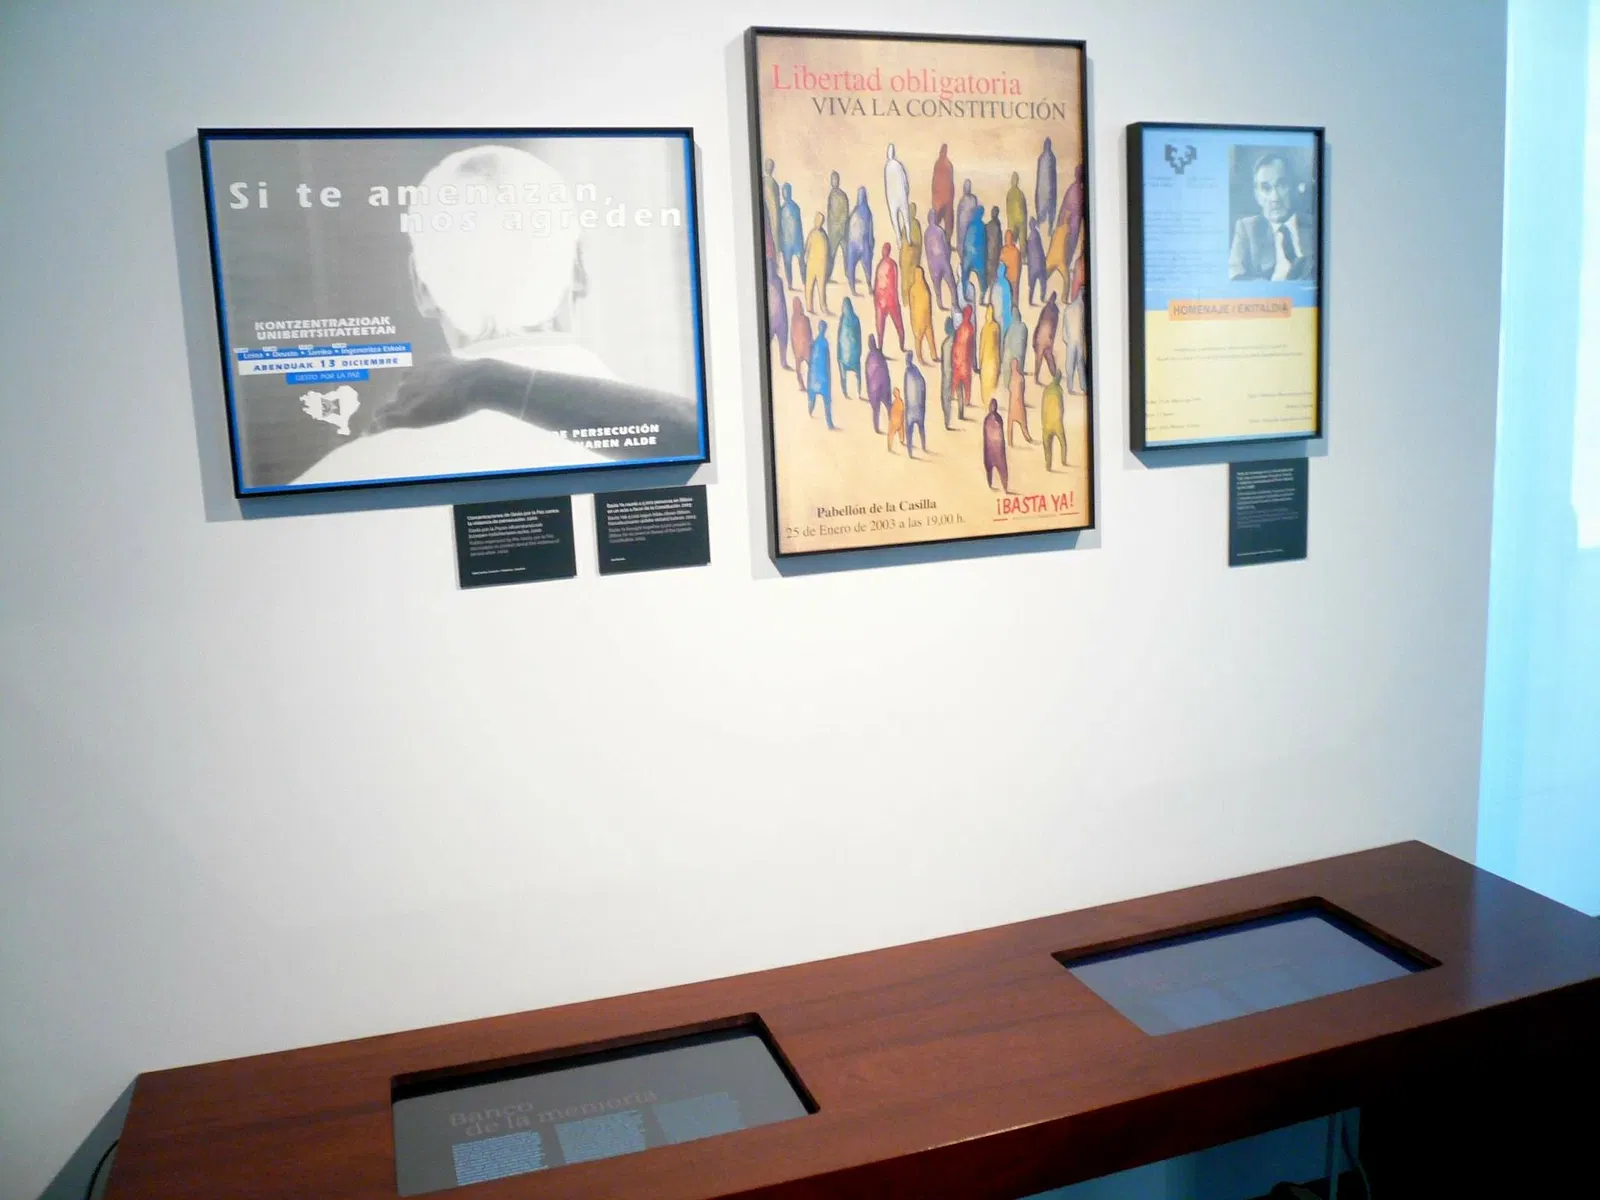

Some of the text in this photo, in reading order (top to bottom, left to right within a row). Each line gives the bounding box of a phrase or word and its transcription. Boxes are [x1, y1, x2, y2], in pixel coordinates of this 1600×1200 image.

[771, 63, 1022, 100] Libertad obligatoria
[812, 97, 1066, 121] VIVA LA CONSTITUCIÓN
[229, 181, 613, 209] Si te amenazan,
[400, 203, 682, 237] nos agreden
[1173, 303, 1229, 316] HOMENAJE
[254, 316, 391, 331] KONTZENTRAZIOAK
[256, 325, 396, 340] UNIBERTSITATEETAN
[253, 357, 398, 372] ABENDUAK 13 DICIEMBRE
[320, 372, 335, 380] POR
[573, 423, 660, 438] PERSECUCIÓN
[624, 436, 657, 447] ALDE
[817, 499, 937, 518] Pabellón de la Casilla
[1051, 491, 1075, 512] YA!
[785, 526, 800, 539] 25
[802, 525, 816, 537] de
[819, 523, 851, 536] Enero
[854, 521, 867, 533] de
[870, 519, 896, 531] 2003
[898, 521, 905, 529] a
[907, 517, 922, 528] las
[451, 1101, 534, 1127] Banco
[465, 1089, 660, 1137] de la memoria
